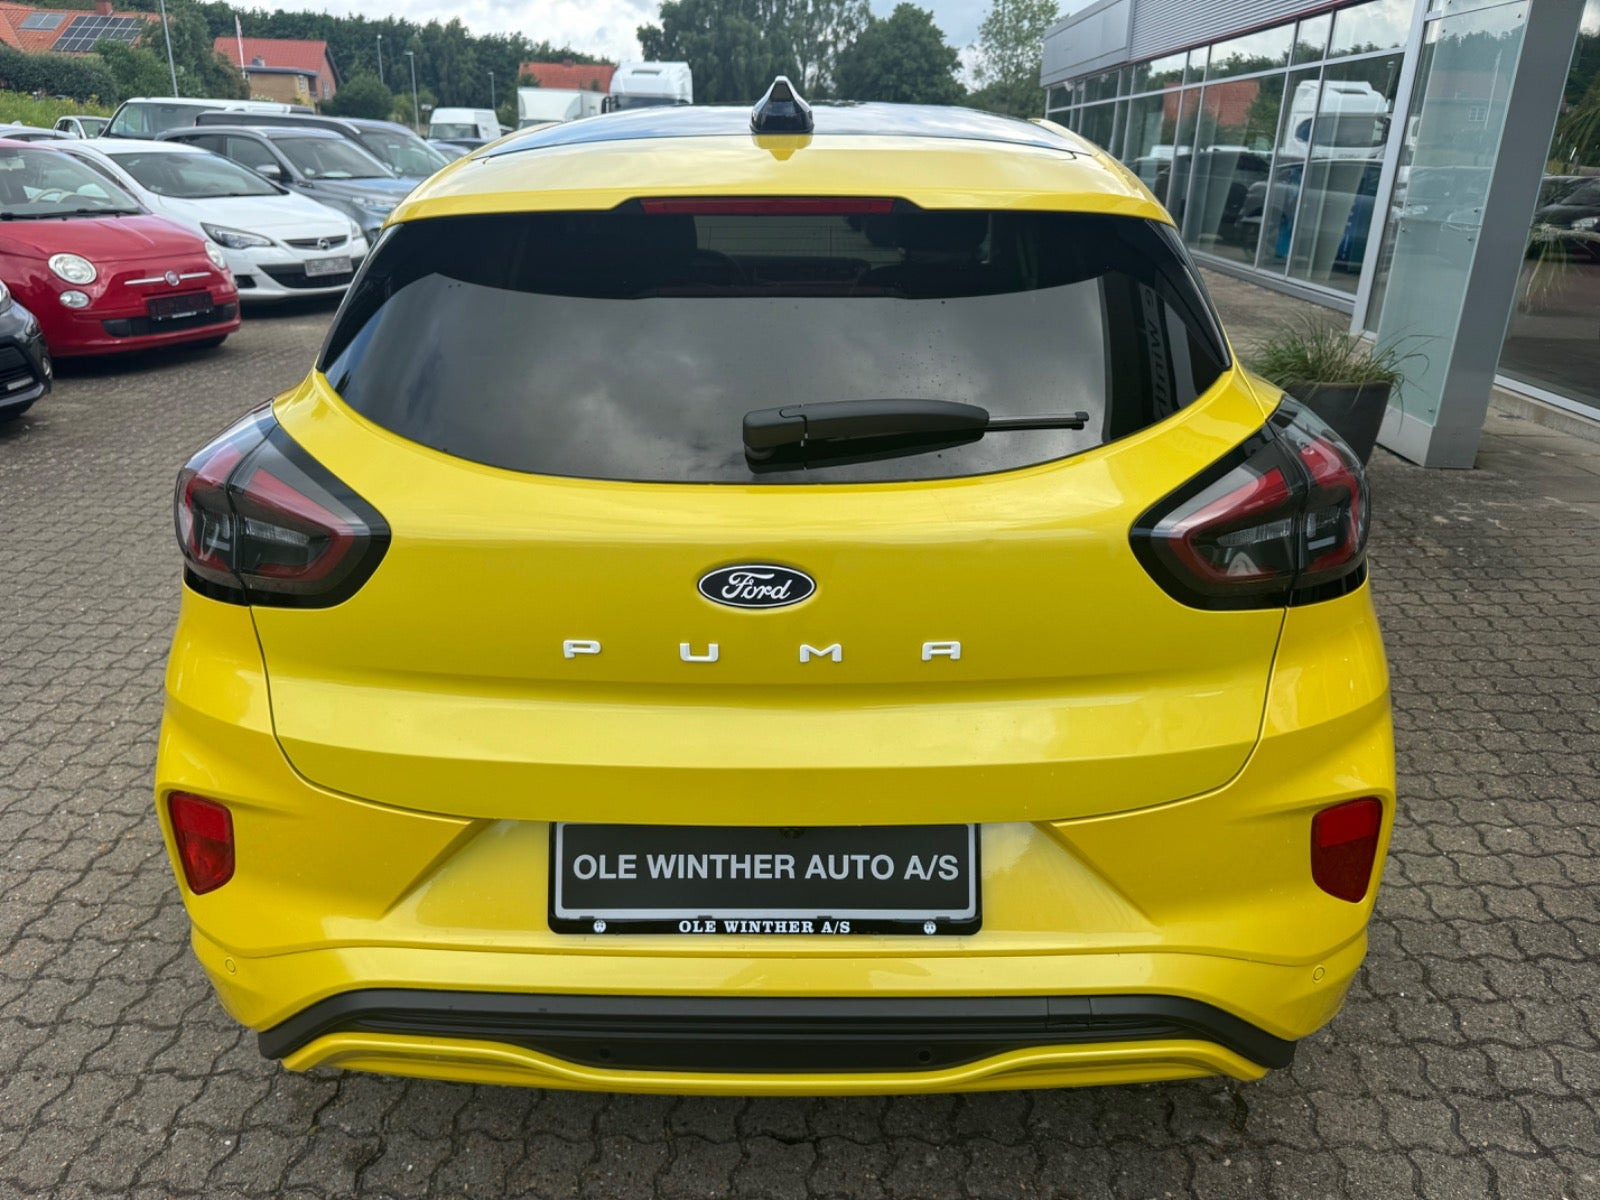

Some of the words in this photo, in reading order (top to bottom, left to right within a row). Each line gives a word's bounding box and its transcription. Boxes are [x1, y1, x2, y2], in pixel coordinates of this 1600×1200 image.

[720, 571, 791, 601] Ford
[562, 639, 963, 663] PUMA
[573, 854, 637, 880] OLE
[646, 854, 796, 880] WINTHER
[804, 854, 895, 881] AUTO
[903, 854, 960, 881] A/S
[678, 919, 717, 934] OLE
[724, 919, 815, 934] WINTHER
[820, 919, 852, 934] A/S
